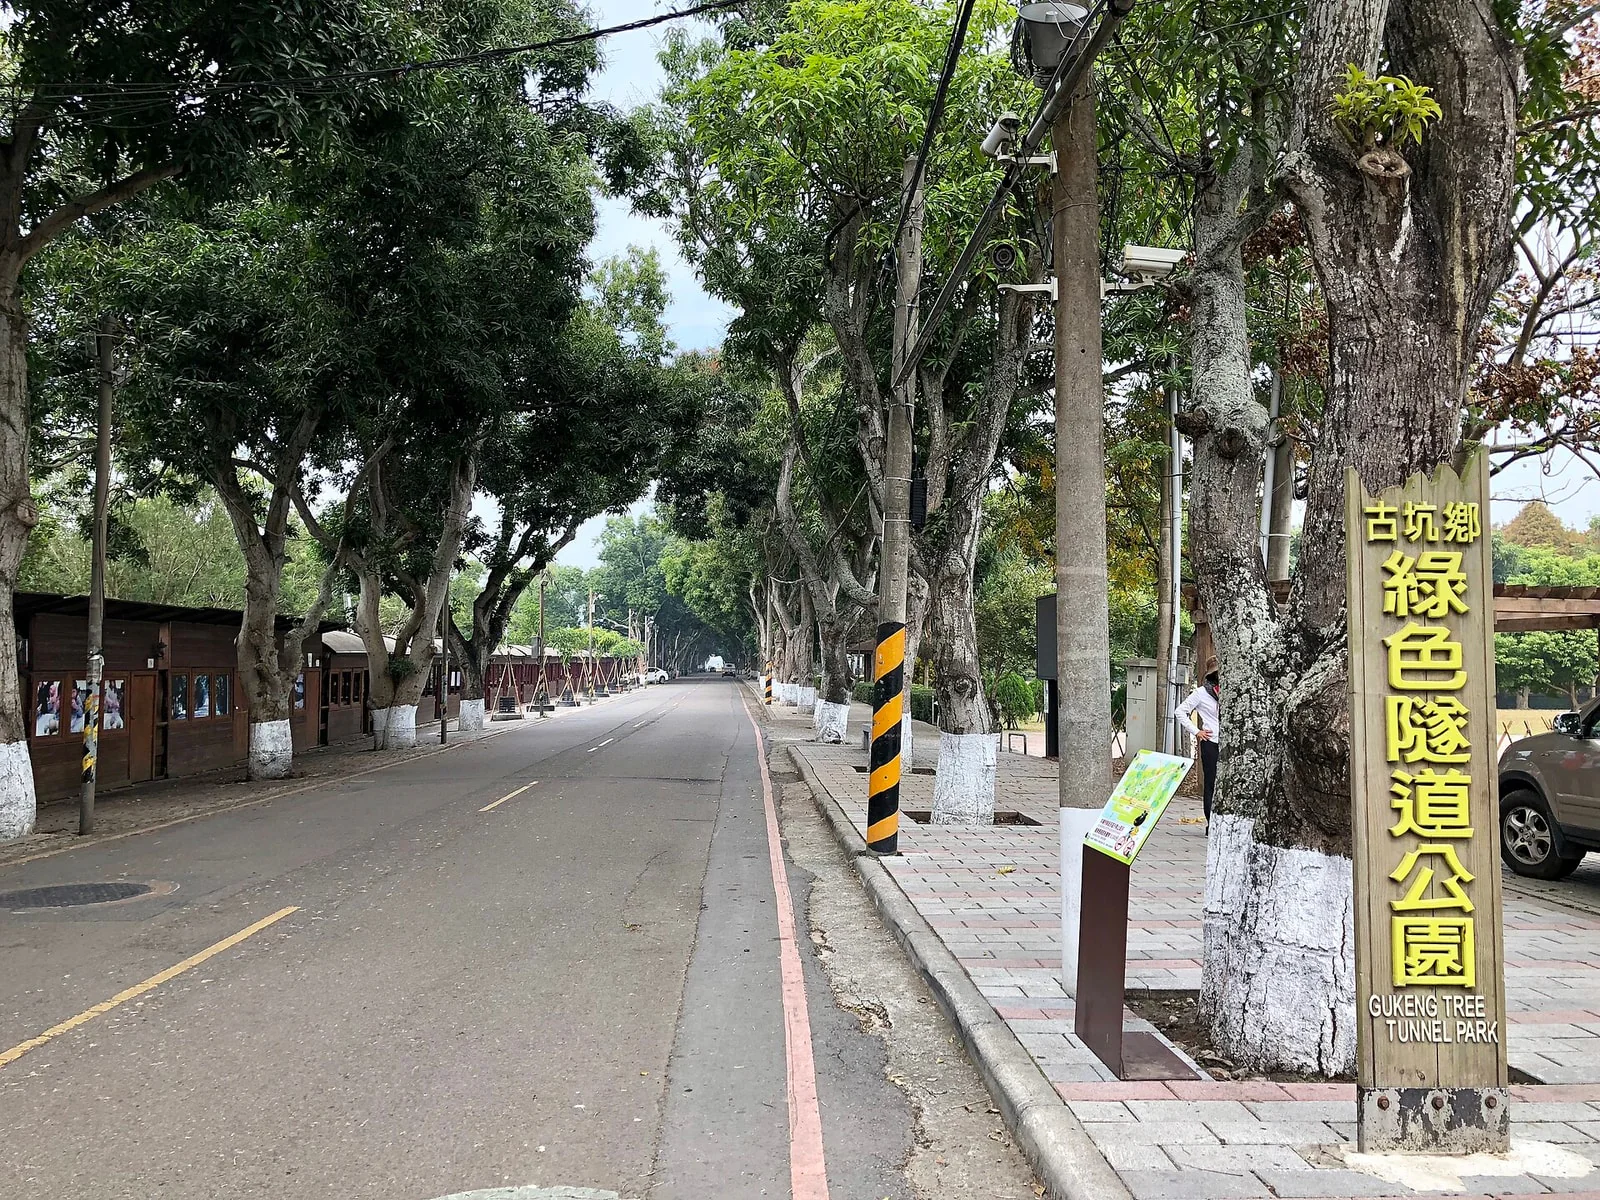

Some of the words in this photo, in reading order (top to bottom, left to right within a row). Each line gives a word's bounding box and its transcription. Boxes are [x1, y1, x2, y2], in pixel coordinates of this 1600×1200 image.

[1364, 501, 1481, 543] 古坑鄉
[1381, 550, 1475, 987] 綠色隧道公園
[1369, 994, 1438, 1018] GUKENG
[1443, 995, 1486, 1018] TREE
[1386, 1020, 1453, 1043] TUNNEL
[1456, 1020, 1499, 1043] PARK
